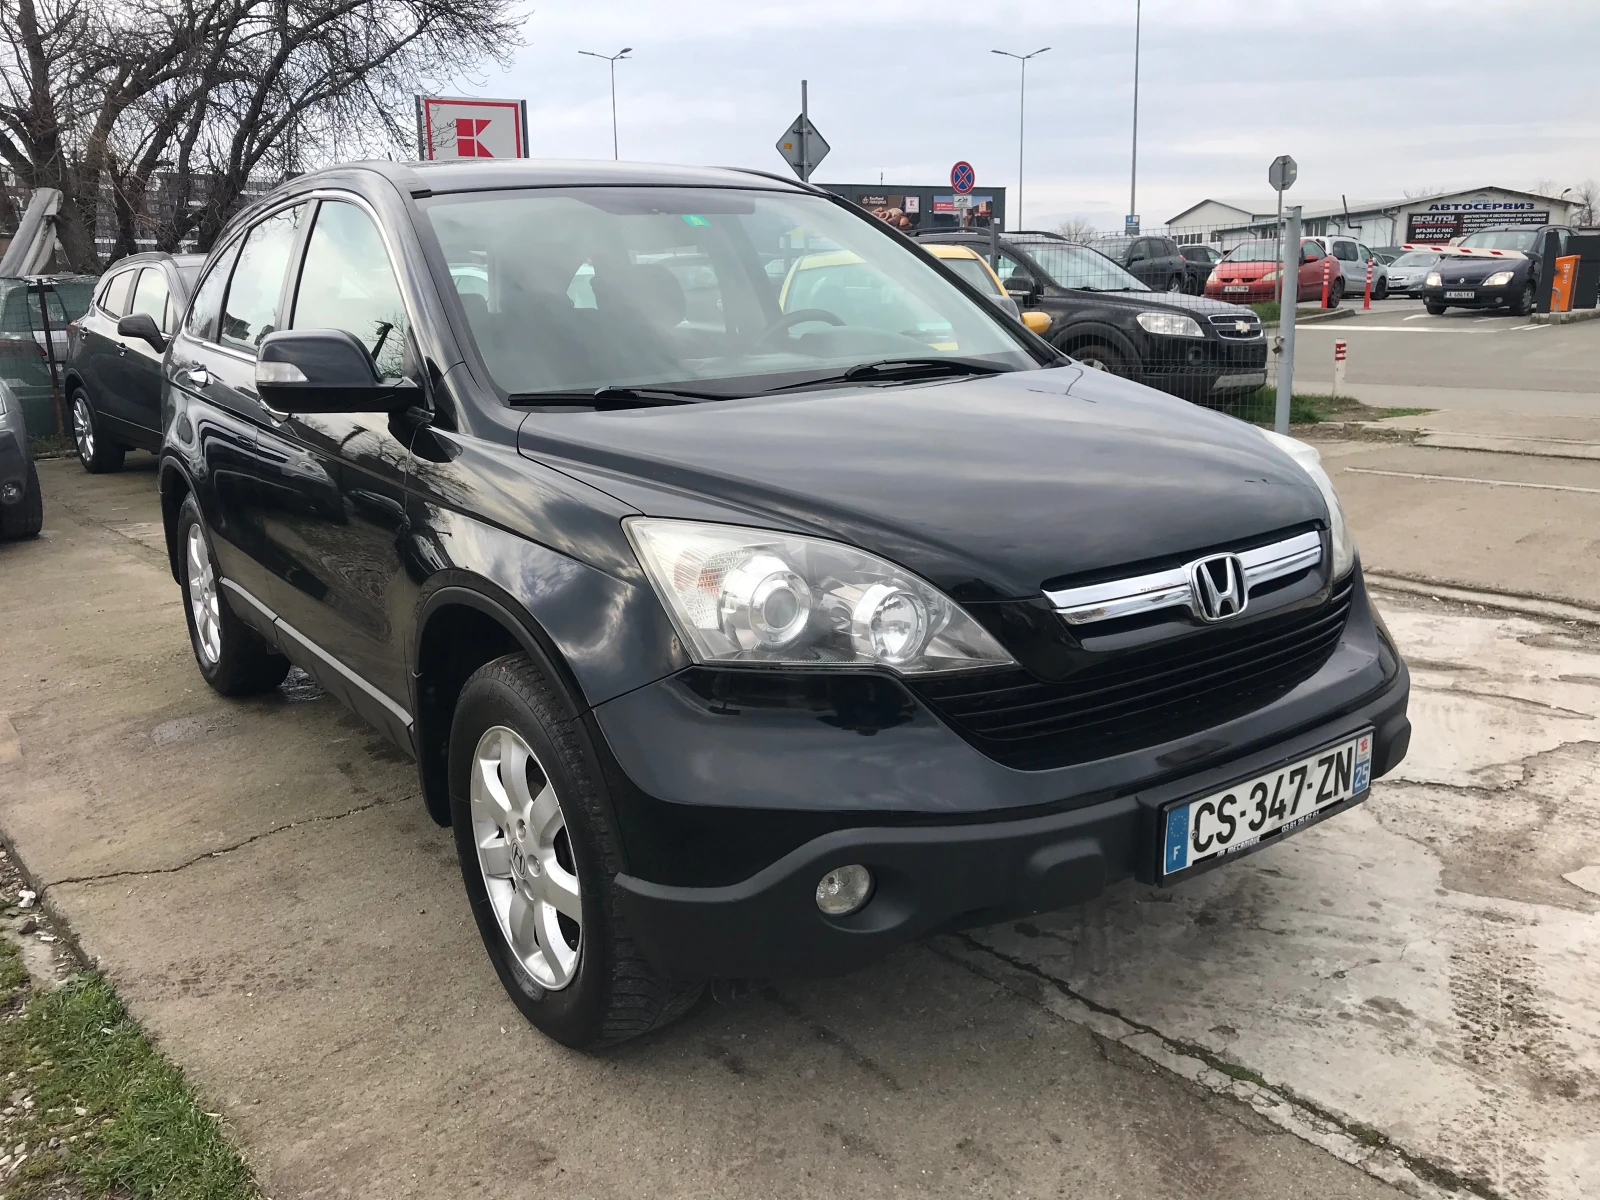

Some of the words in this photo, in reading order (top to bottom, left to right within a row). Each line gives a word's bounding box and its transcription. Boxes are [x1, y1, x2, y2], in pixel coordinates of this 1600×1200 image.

[1429, 203, 1535, 211] АВТОСЕРВИЗ
[1355, 763, 1369, 788] 25
[1193, 746, 1353, 853] CS-347-ZN
[1173, 845, 1181, 861] F
